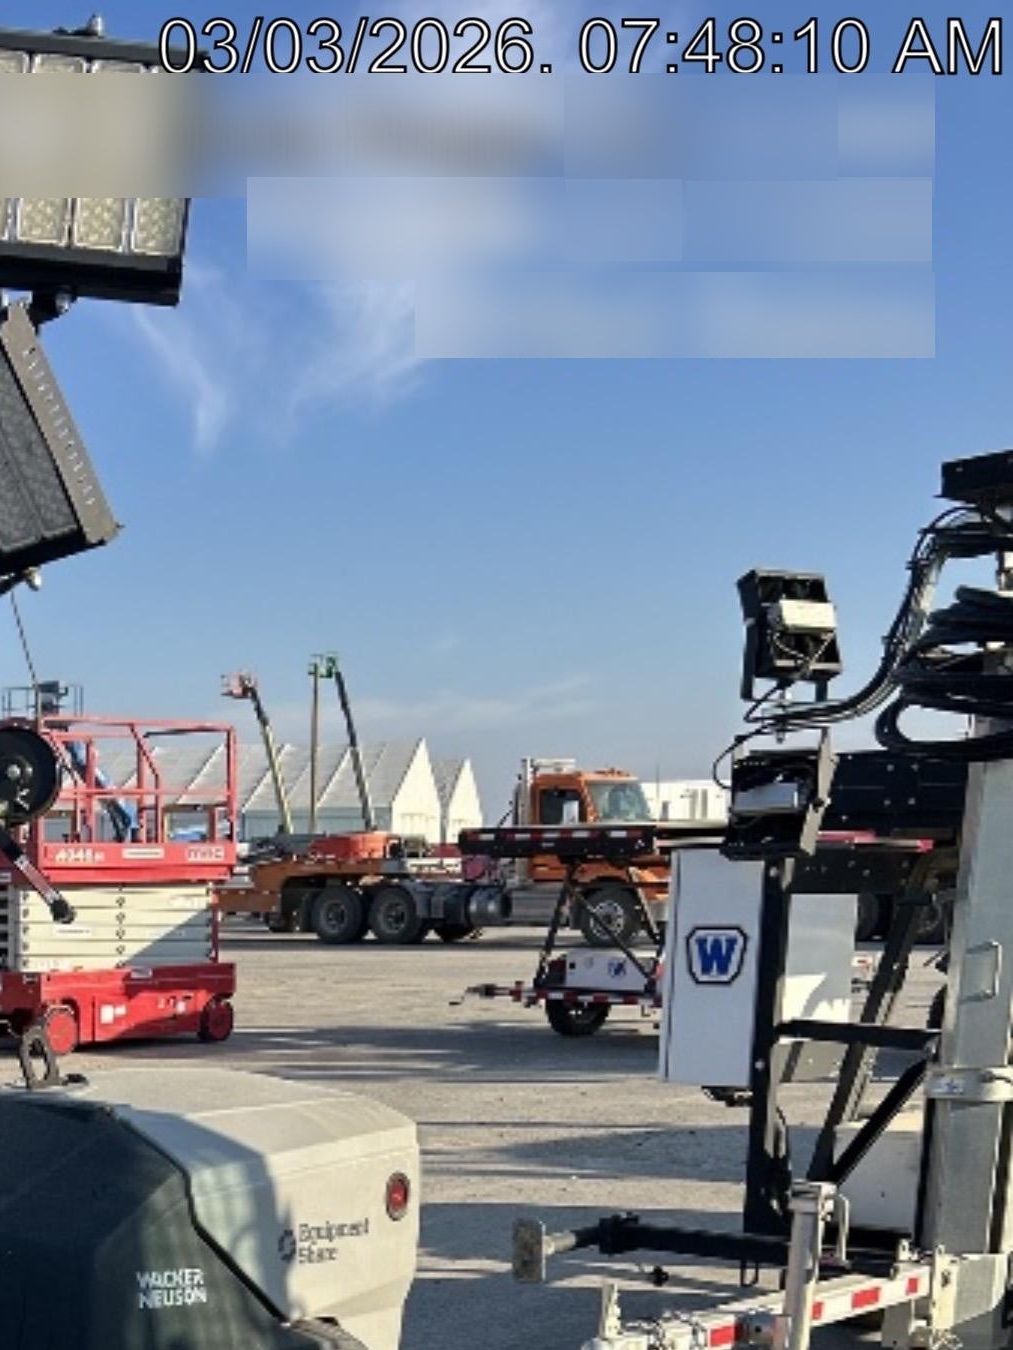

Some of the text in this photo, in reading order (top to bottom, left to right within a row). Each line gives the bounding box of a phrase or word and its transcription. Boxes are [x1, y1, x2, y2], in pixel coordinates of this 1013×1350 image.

[694, 935, 738, 976] W
[136, 1268, 205, 1289] WACKER
[137, 1286, 208, 1309] NEUSON
